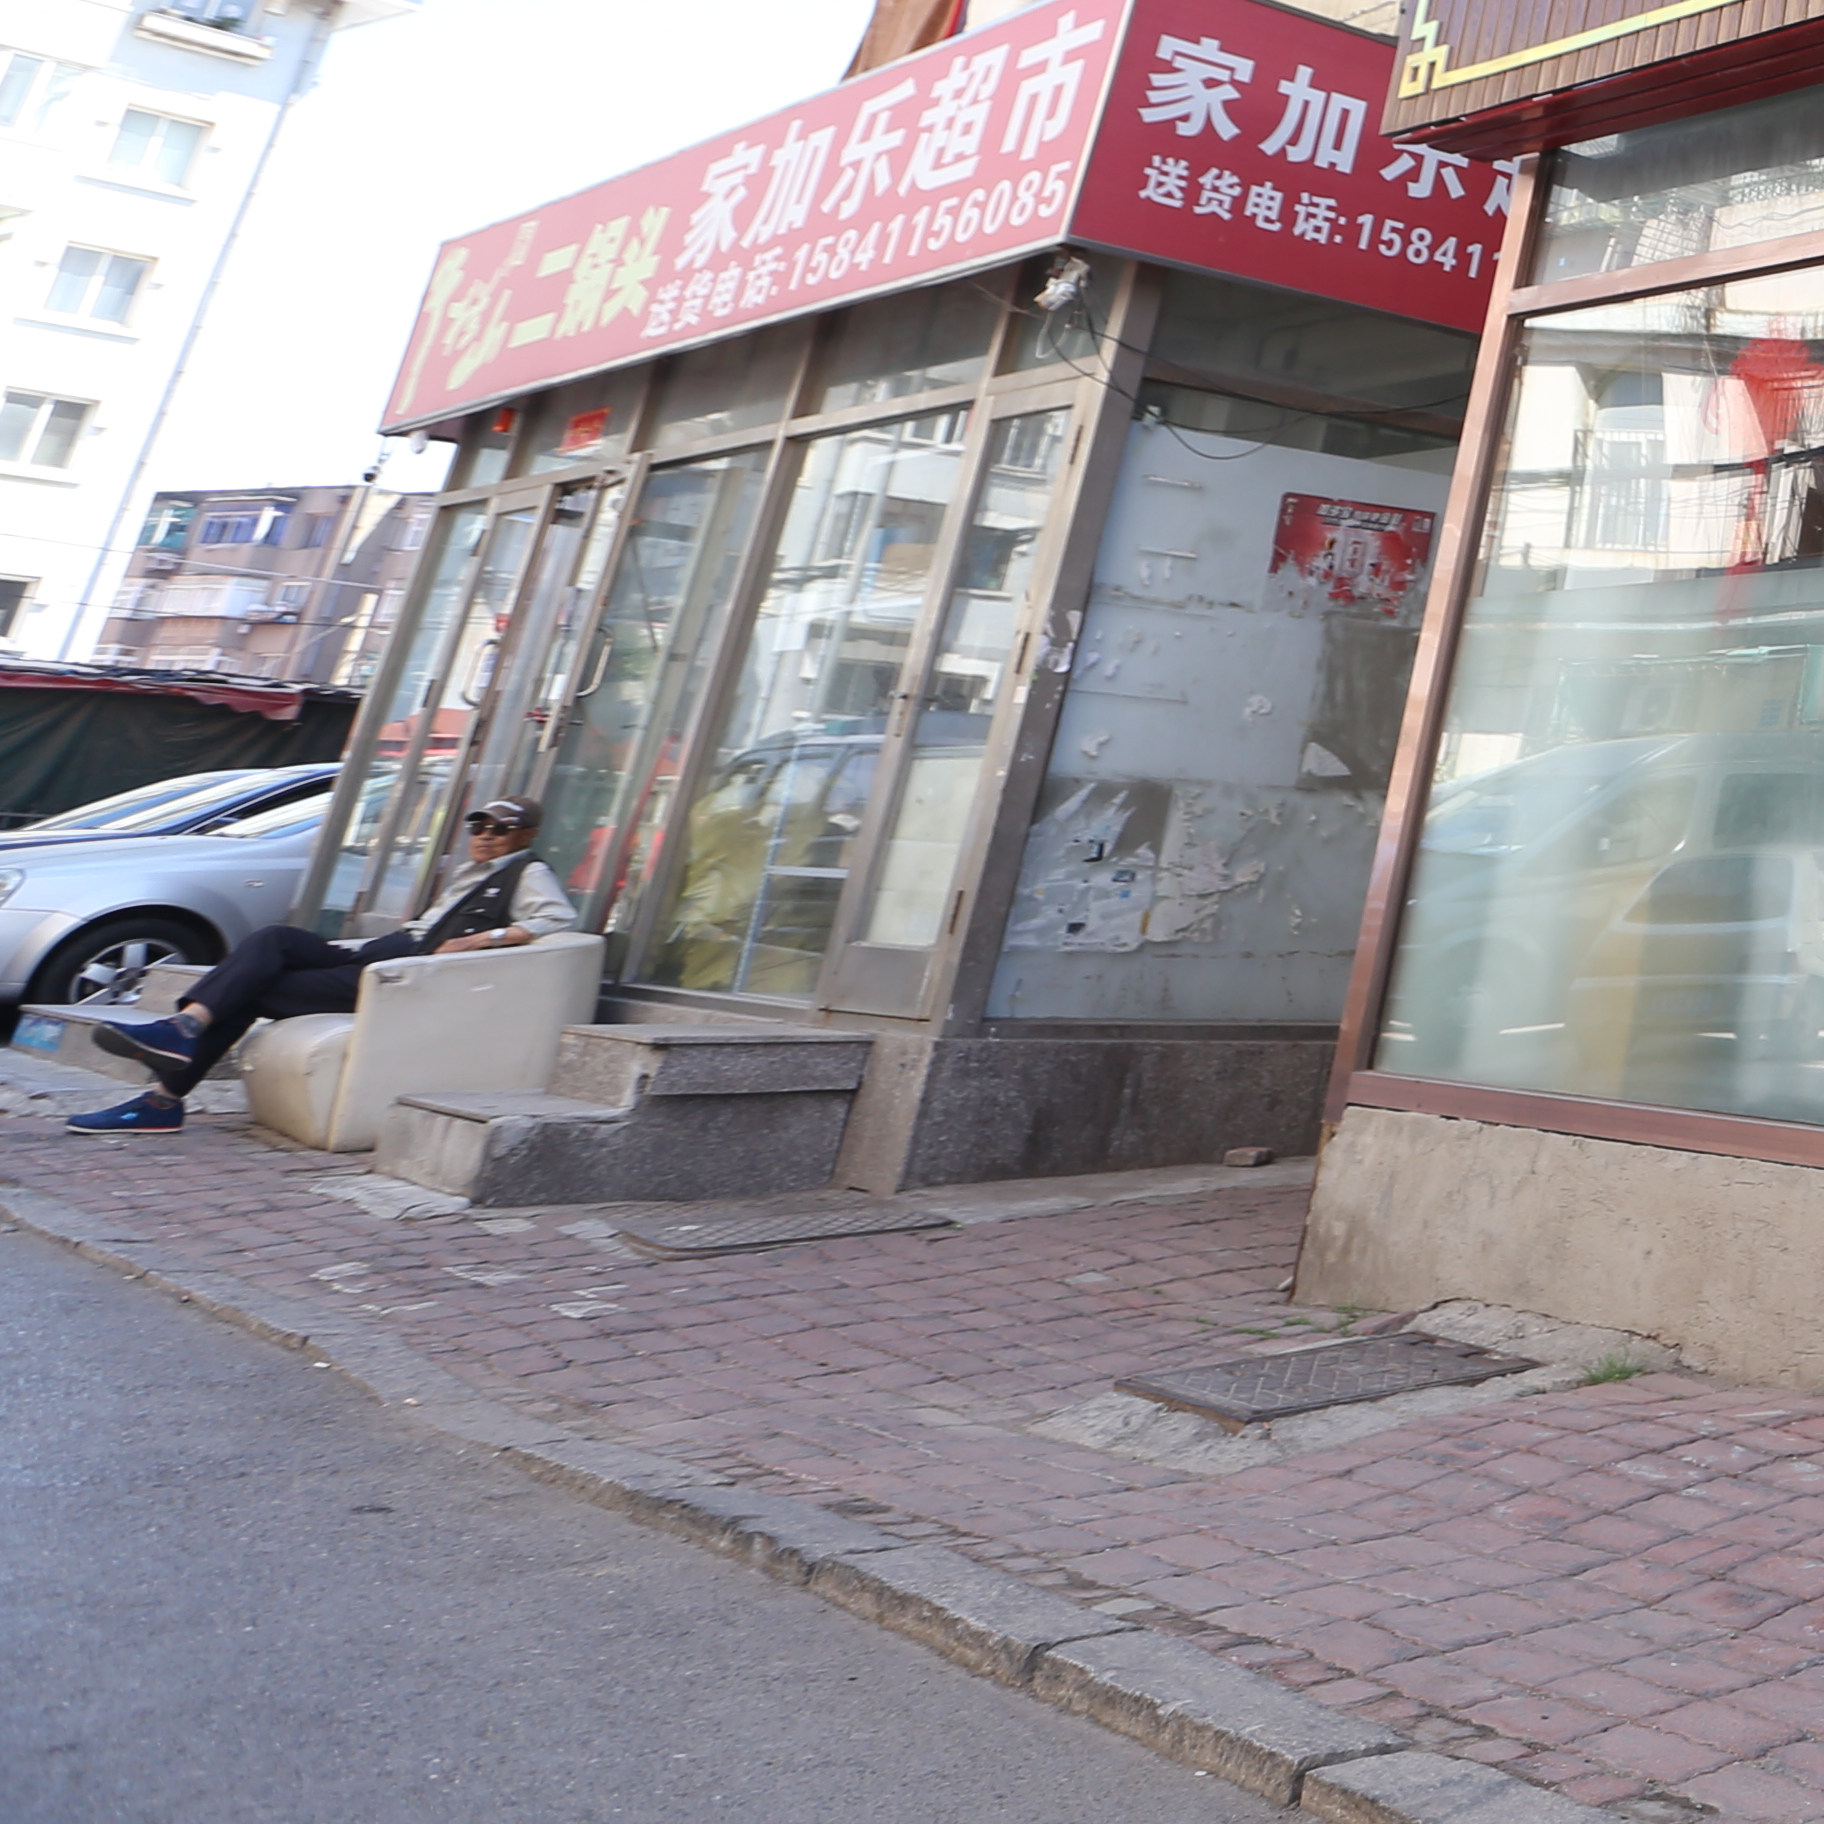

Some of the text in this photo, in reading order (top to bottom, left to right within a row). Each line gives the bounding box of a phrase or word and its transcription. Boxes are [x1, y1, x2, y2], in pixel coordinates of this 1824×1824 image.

[675, 9, 1106, 270] 家加乐超市
[1137, 154, 1505, 279] 送货电话:15841
